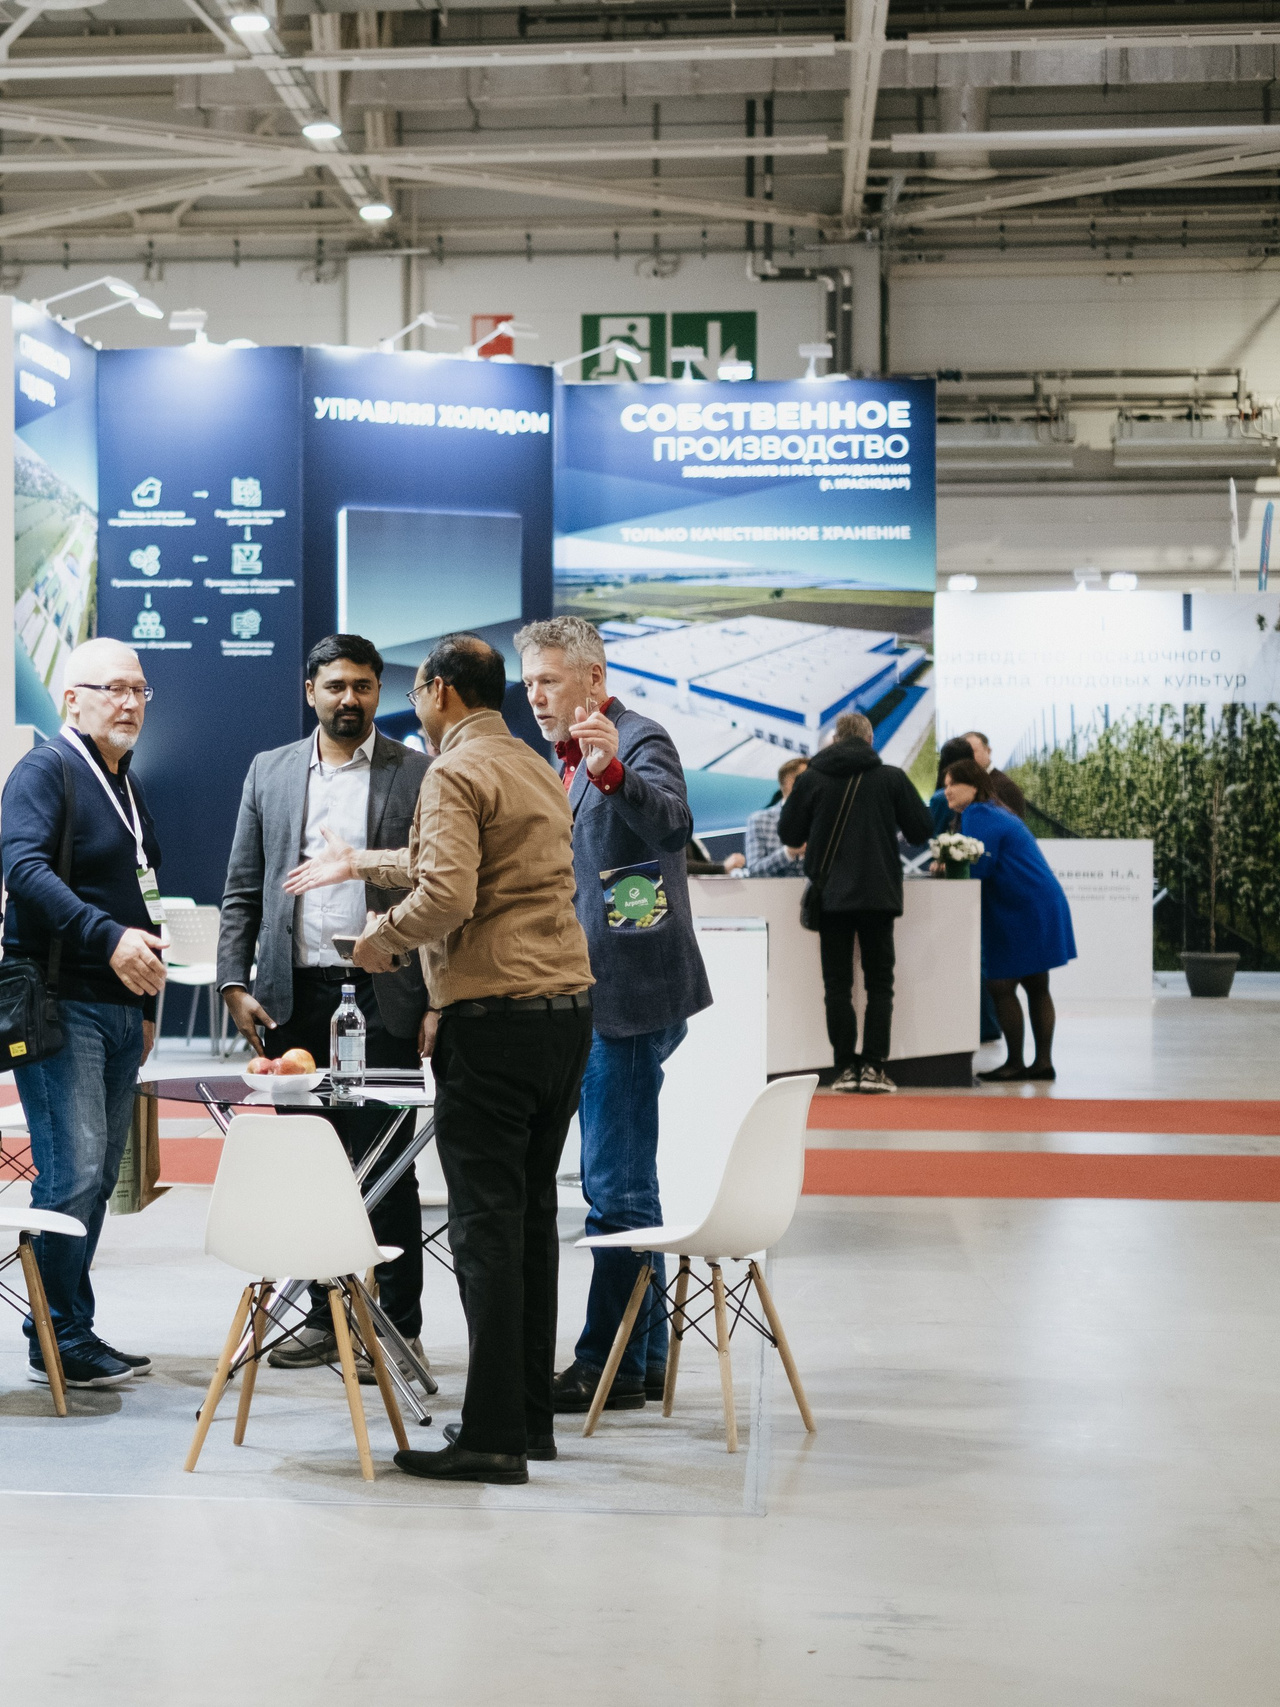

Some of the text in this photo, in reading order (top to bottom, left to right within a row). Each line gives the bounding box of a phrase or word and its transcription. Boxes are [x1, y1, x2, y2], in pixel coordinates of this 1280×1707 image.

[314, 396, 550, 435] УПРАВЛЯЯ ХОЛОДОМ
[621, 400, 912, 433] СОБСТВЕННОЕ
[653, 434, 910, 464] ПРОИЗВОДСТВО
[621, 526, 911, 542] ТОЛЬКО КАЧЕСТВЕННОЕ ХРАНЕНИЕ
[938, 650, 1066, 664] оизводство
[942, 673, 1032, 689] териала
[1163, 672, 1248, 691] культур
